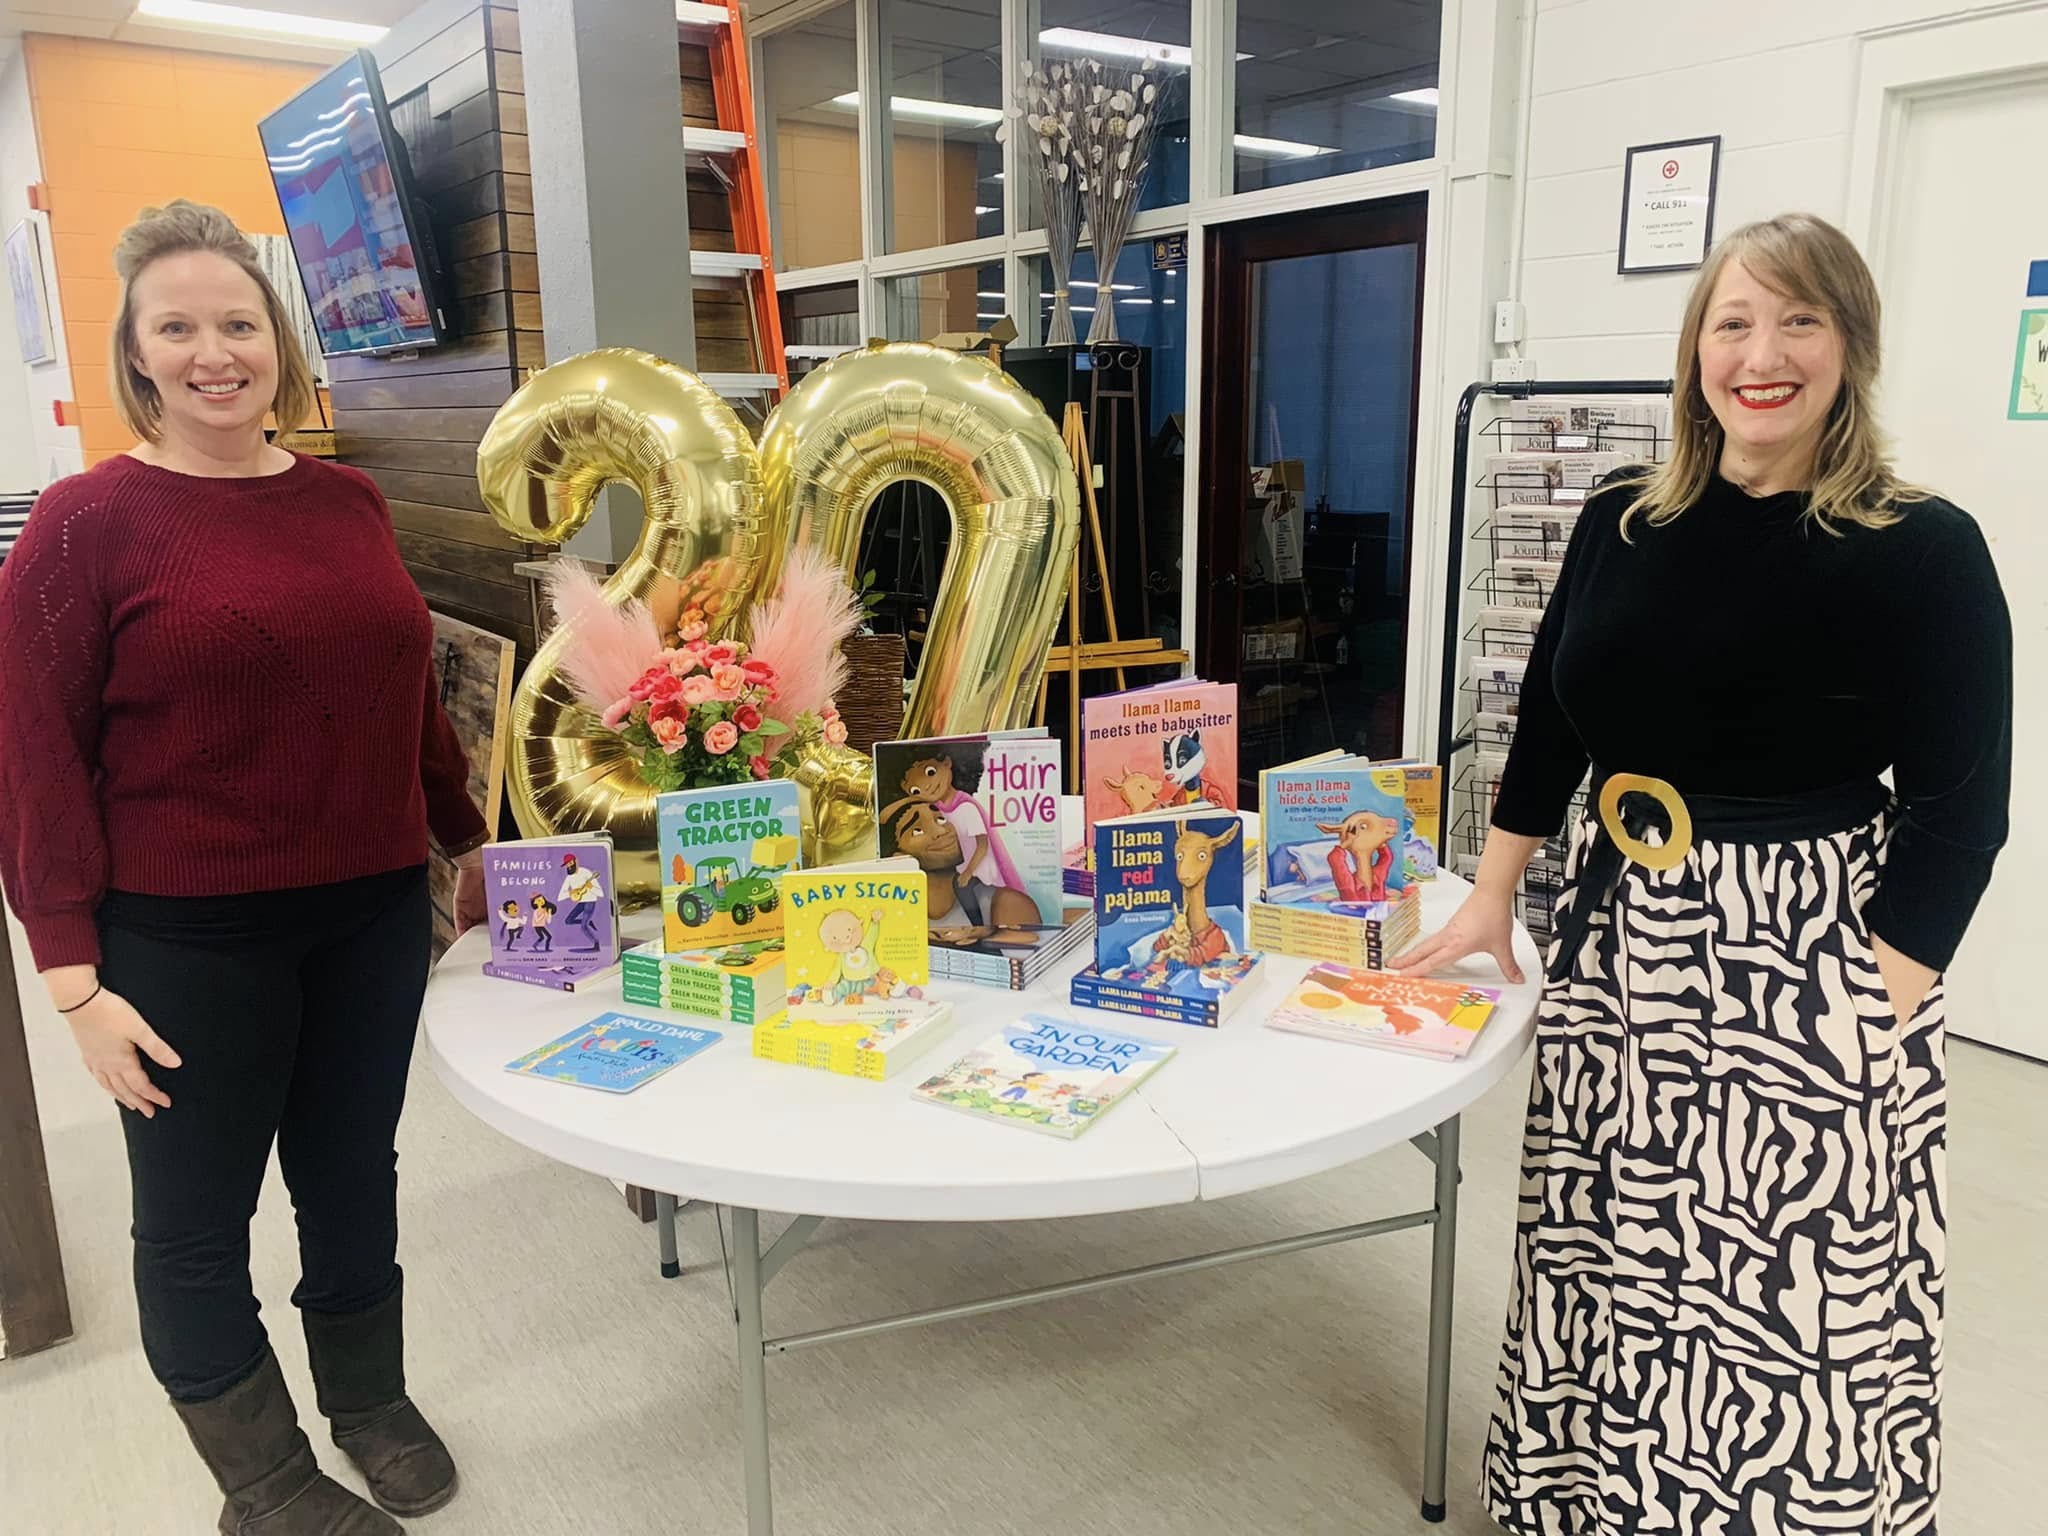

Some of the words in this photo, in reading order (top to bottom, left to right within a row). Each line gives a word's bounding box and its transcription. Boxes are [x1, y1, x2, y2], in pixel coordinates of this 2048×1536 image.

[1650, 200, 1670, 210] CALL
[1672, 200, 1687, 208] 911
[1510, 492, 1549, 504] Journa
[1501, 644, 1532, 656] Journ
[1122, 703, 1160, 718] llama
[1164, 699, 1201, 713] llama
[1090, 724, 1131, 740] meets
[1136, 720, 1158, 735] the
[1162, 713, 1232, 734] babysitter
[988, 753, 1057, 792] Hair
[1277, 780, 1312, 792] llama
[1315, 779, 1350, 791] llama
[1279, 794, 1304, 805] hide
[1308, 795, 1318, 804] &
[1321, 793, 1348, 804] seek
[685, 797, 772, 824] GREEN
[989, 792, 1056, 828] Love
[677, 818, 784, 848] TRACTOR
[1112, 830, 1163, 848] llama
[494, 860, 552, 872] FAMILIES
[1112, 850, 1164, 868] llama
[501, 876, 546, 887] BELONG
[1122, 866, 1154, 886] red
[791, 884, 846, 908] BABY
[856, 882, 920, 904] SIGNS
[1104, 888, 1172, 914] pajama
[497, 970, 524, 980] FAMILIES
[525, 975, 546, 985] BELONG
[1098, 986, 1120, 996] LLAMA
[1121, 990, 1142, 1000] LLAMA
[1351, 983, 1449, 1002] SNOWY
[1098, 1000, 1120, 1010] LLAMA
[1120, 1003, 1142, 1014] LLAMA
[608, 1016, 663, 1032] ROALD
[660, 1026, 706, 1041] DAHL
[1031, 1024, 1070, 1044] IN
[1074, 1034, 1140, 1058] OUR
[1008, 1036, 1129, 1075] GARDEN
